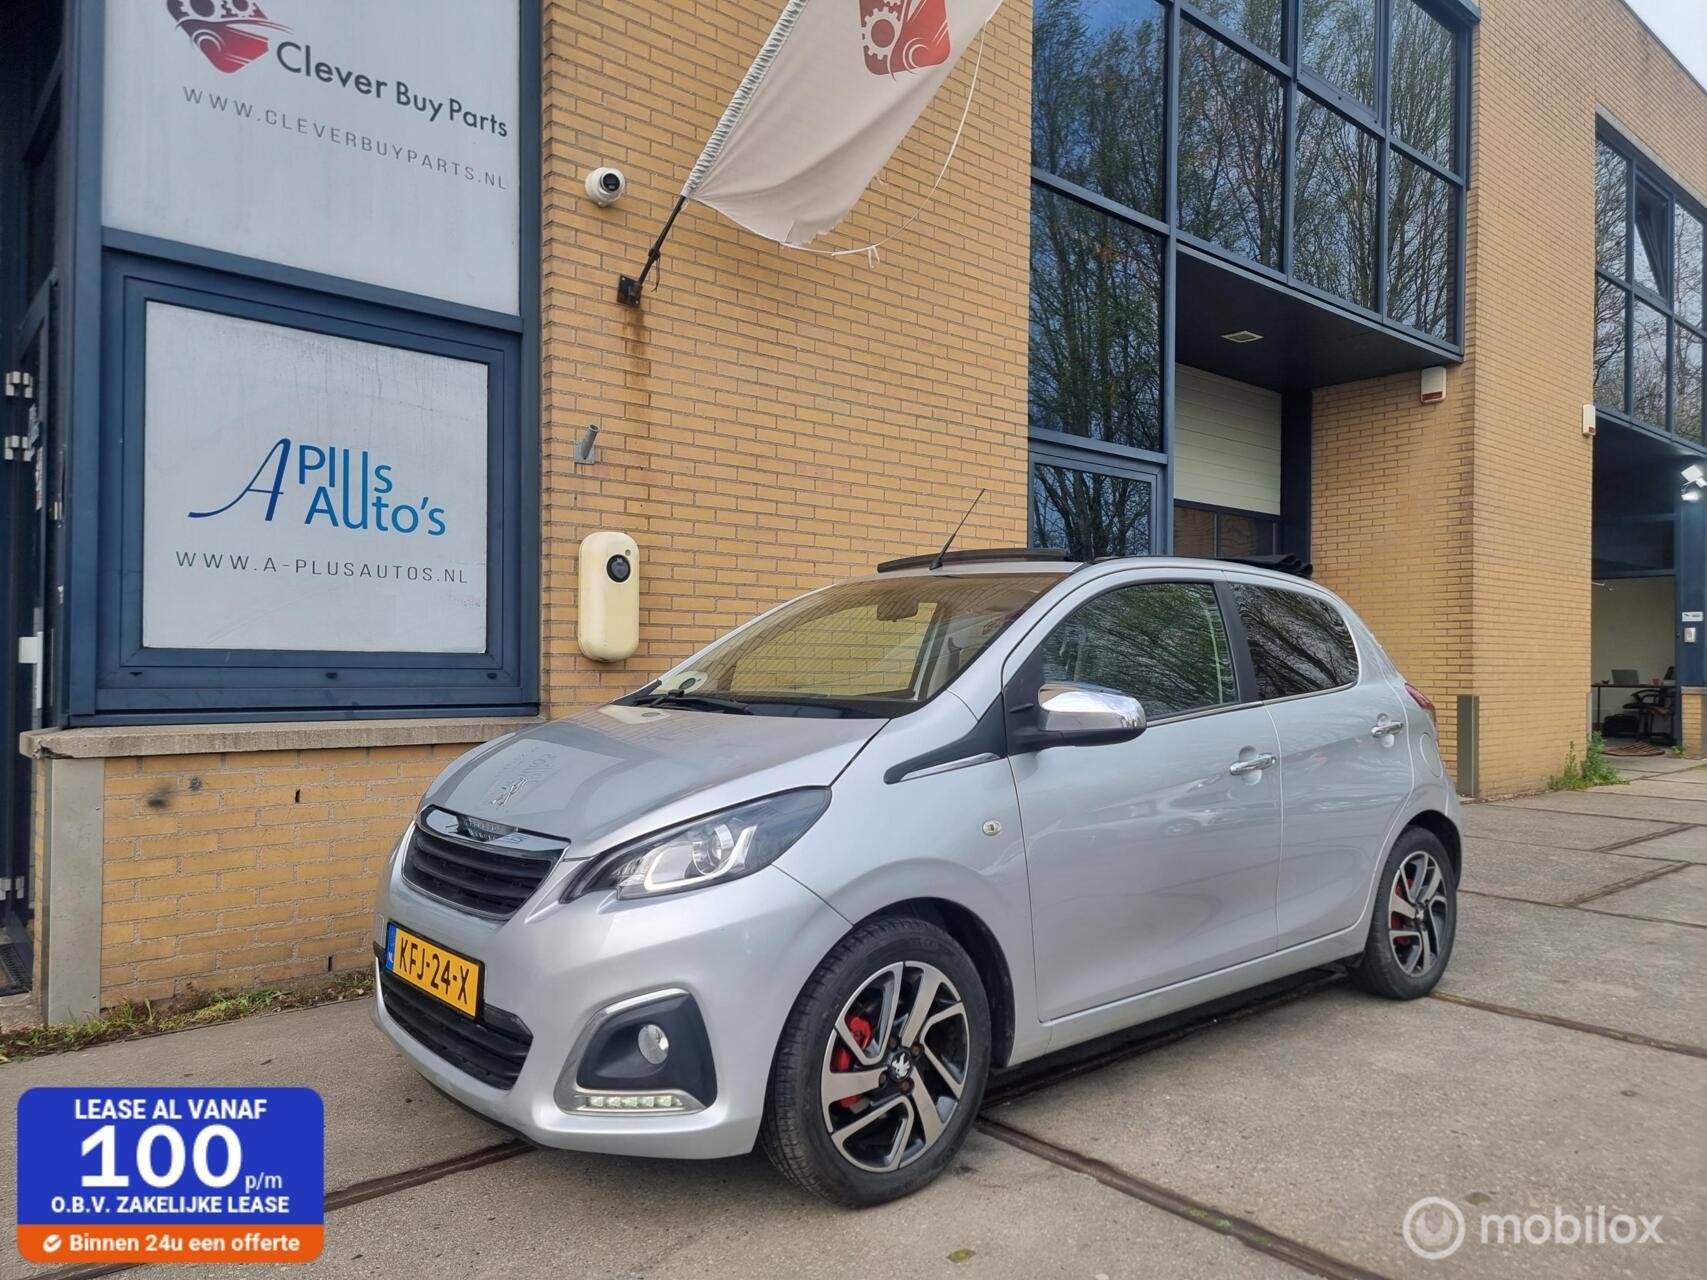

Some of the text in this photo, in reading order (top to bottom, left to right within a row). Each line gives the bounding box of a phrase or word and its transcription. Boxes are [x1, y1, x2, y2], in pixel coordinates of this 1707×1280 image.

[276, 41, 508, 137] Clever Buy Parts
[183, 85, 507, 190] WWW.CLEVERBUYPARTS.NL
[187, 438, 291, 521] A
[176, 551, 468, 583] WWW.A-PLUSAUTOS.NL
[399, 937, 470, 1005] KFJ-24-X
